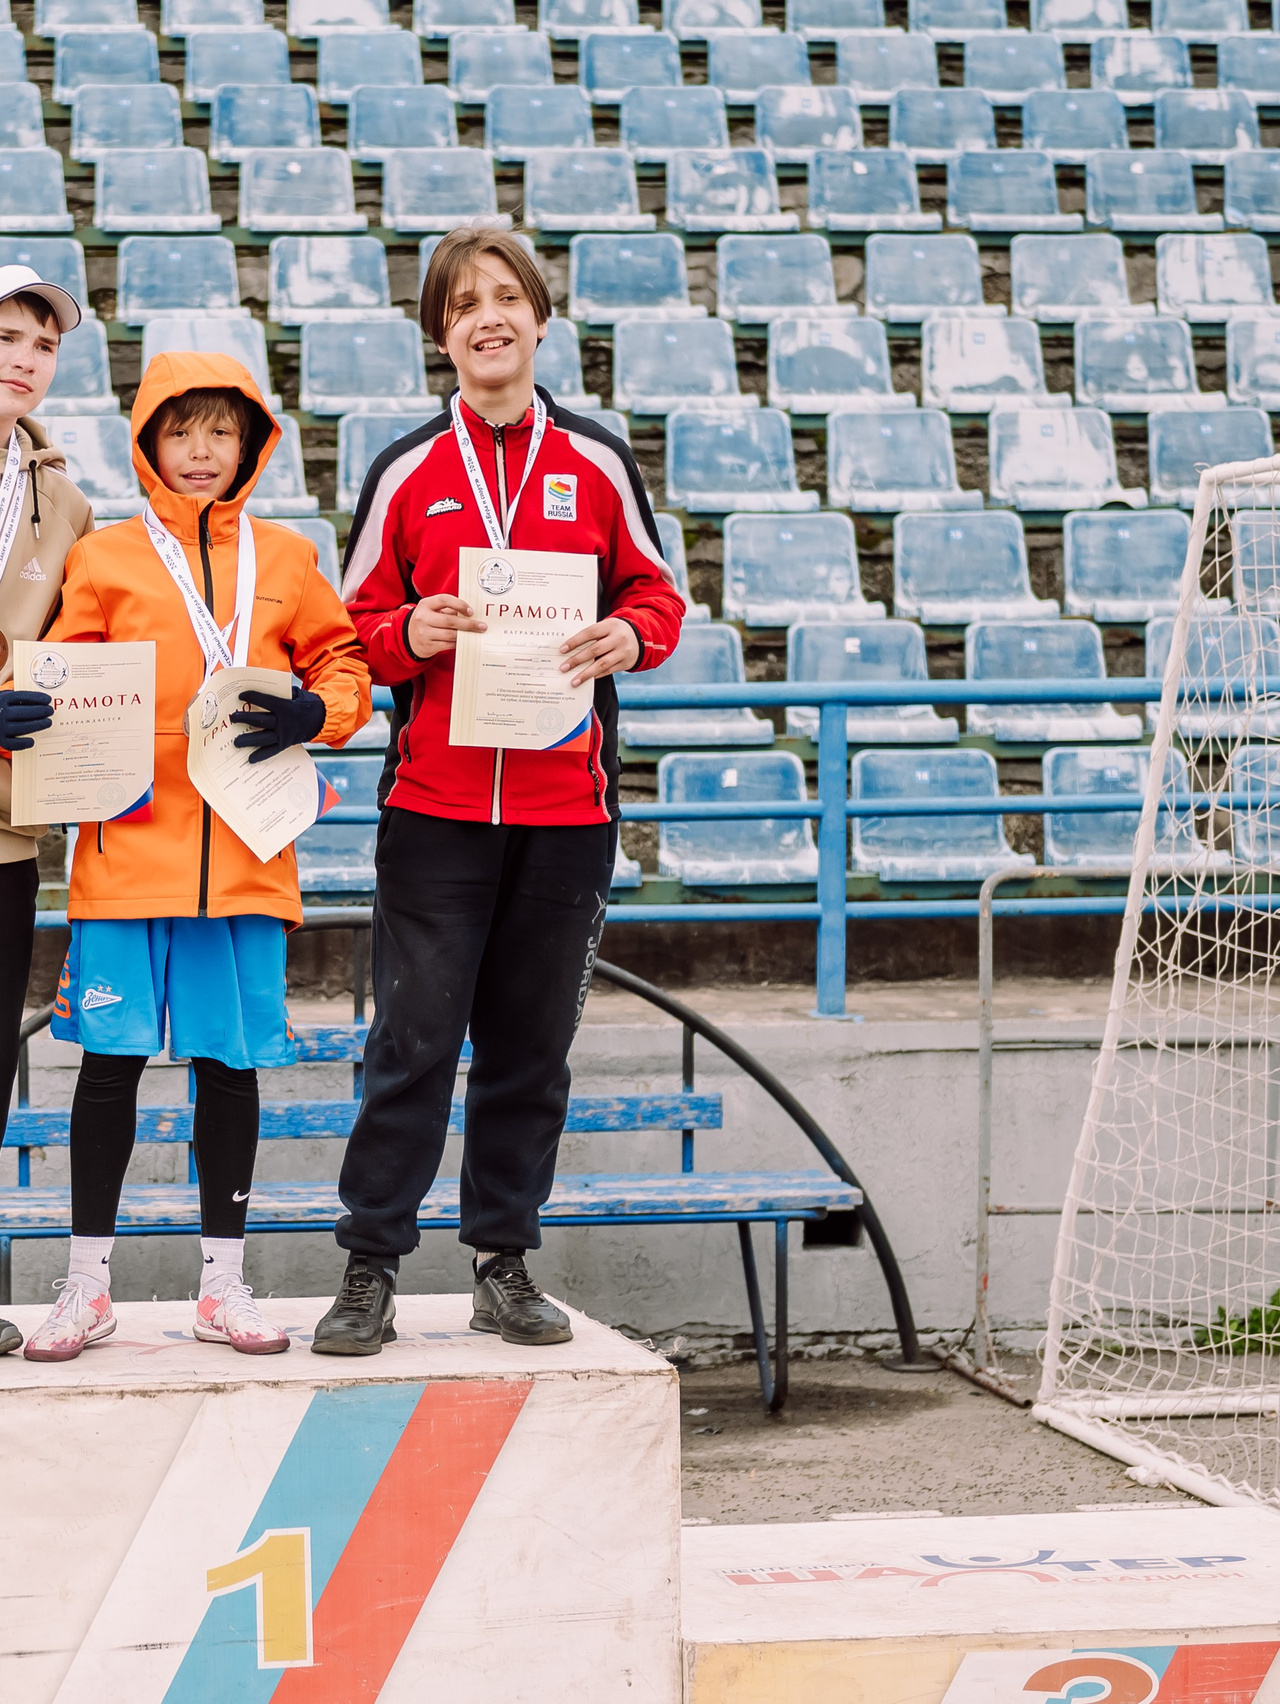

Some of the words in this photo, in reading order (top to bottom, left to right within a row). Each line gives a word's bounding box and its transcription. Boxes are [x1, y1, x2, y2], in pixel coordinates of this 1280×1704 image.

[550, 504, 571, 512] TEAM
[19, 570, 47, 582] adidas
[485, 603, 584, 622] ГРАМОТА
[53, 693, 142, 711] РАМОТА
[1072, 1570, 1246, 1586] СТАДИОН
[206, 1525, 315, 1670] 1
